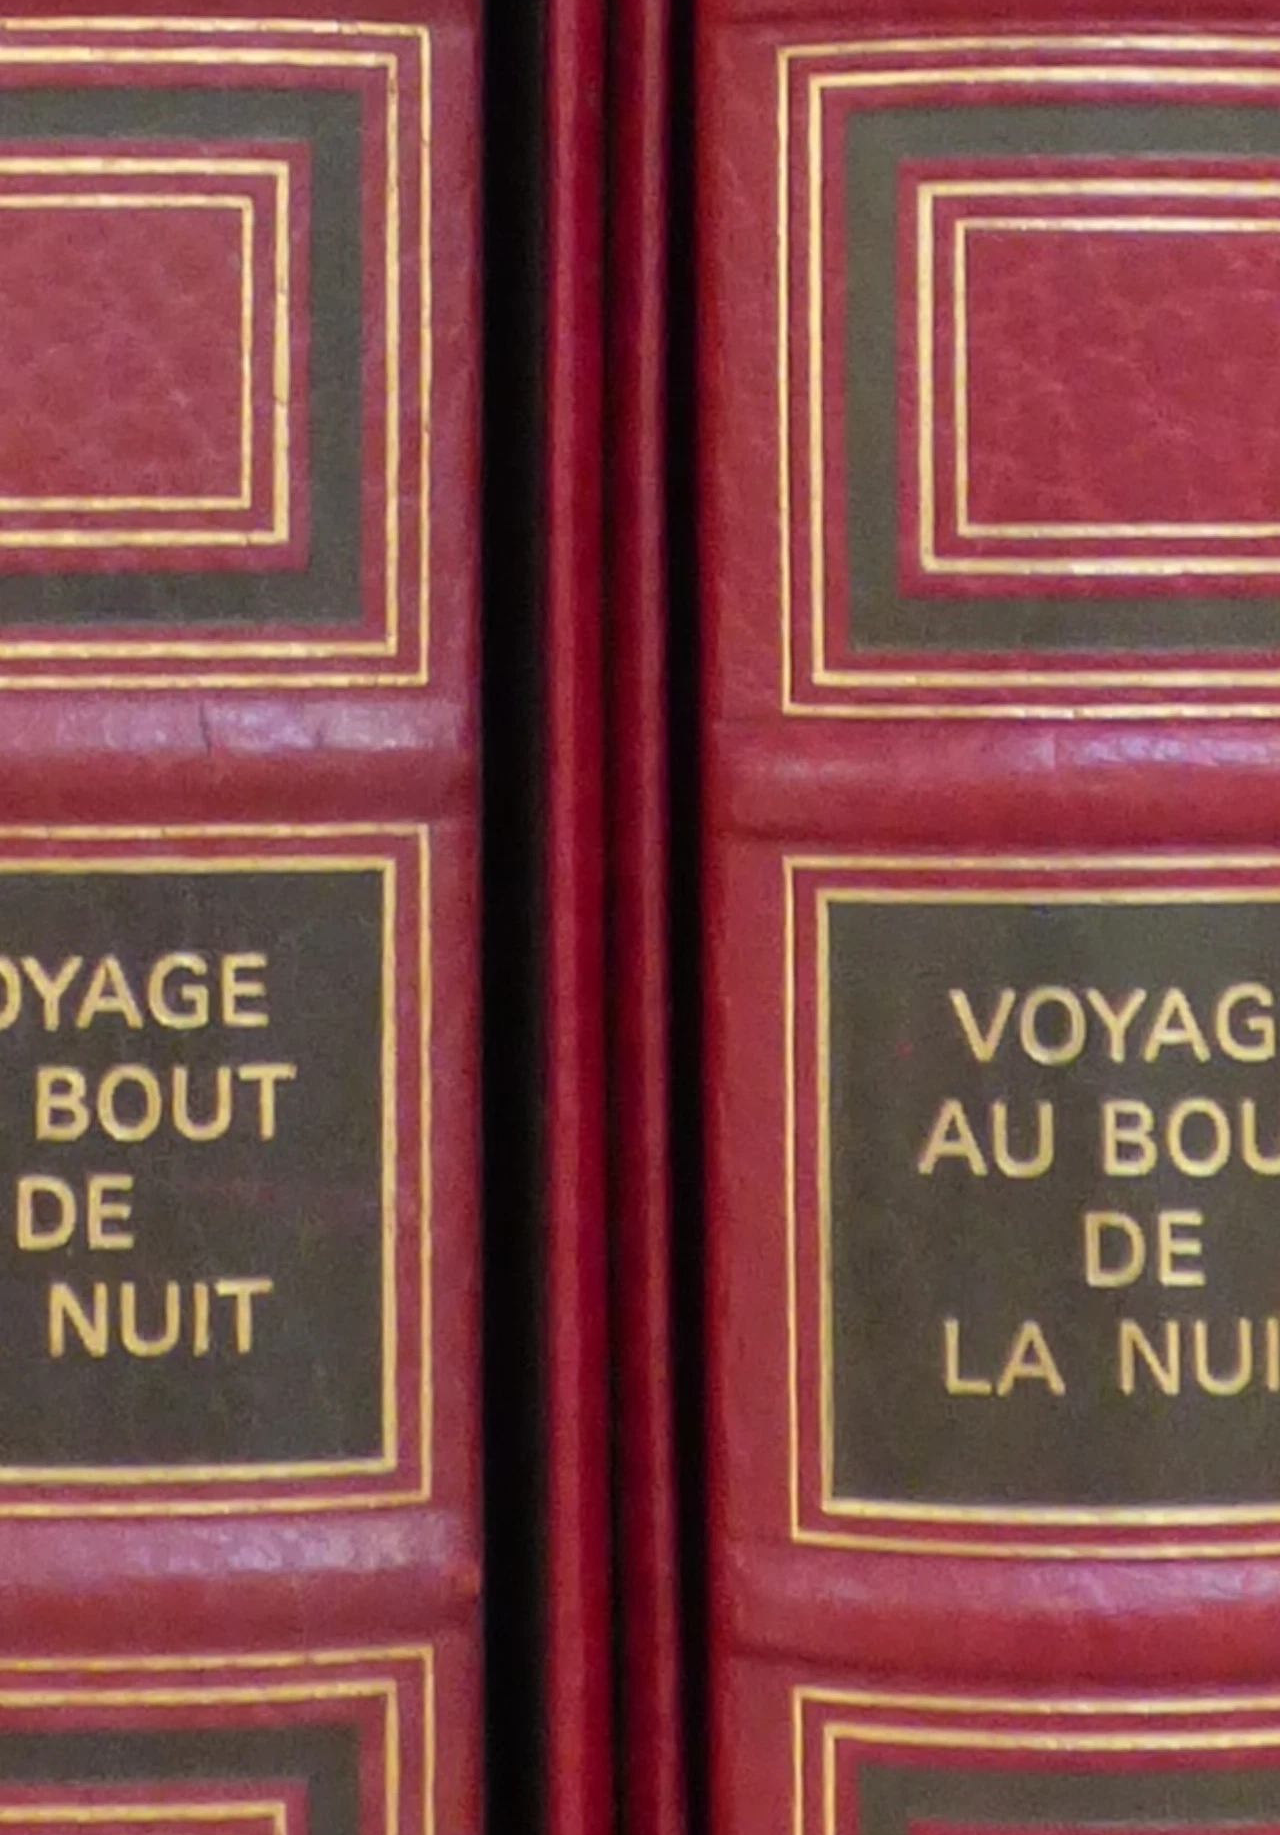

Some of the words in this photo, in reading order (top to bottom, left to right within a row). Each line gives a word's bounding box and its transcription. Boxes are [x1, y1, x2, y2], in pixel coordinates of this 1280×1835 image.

[35, 1061, 298, 1143] BOUT
[916, 1098, 1055, 1179] AU
[16, 1173, 135, 1252] DE
[1084, 1208, 1207, 1288] DE
[48, 1277, 275, 1358] NUIT
[943, 1317, 1067, 1398] LA
